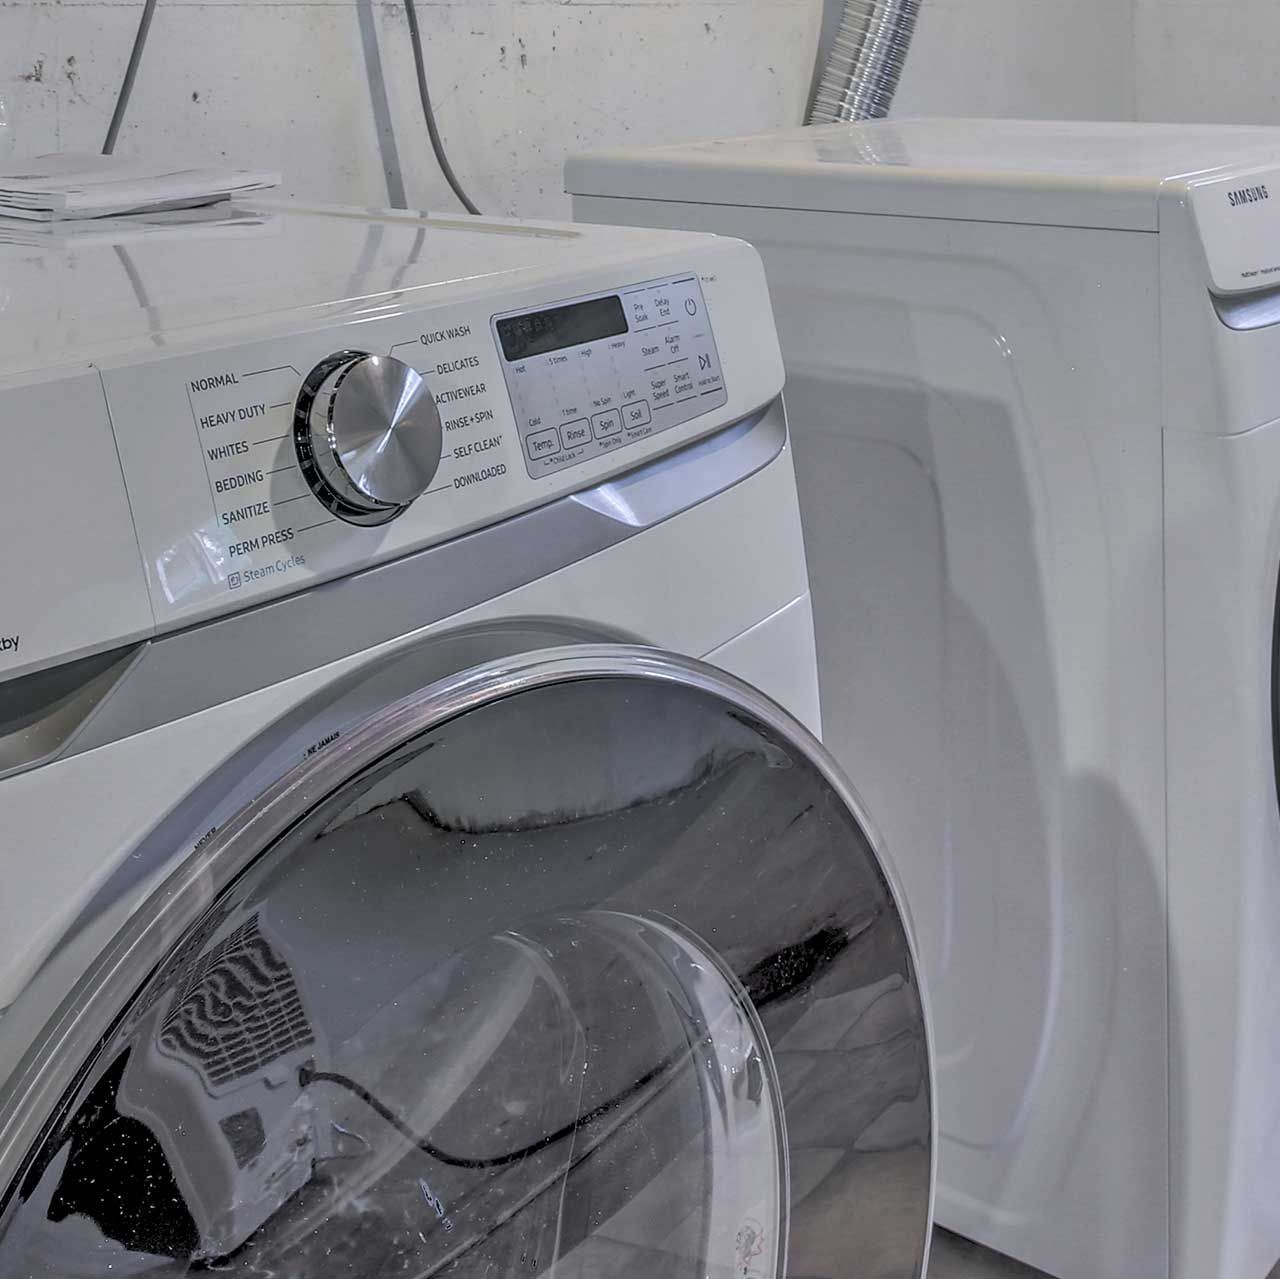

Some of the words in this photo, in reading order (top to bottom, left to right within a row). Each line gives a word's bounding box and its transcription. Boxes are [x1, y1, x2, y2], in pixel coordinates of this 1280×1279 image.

[1228, 185, 1268, 206] SAMSUNG
[420, 330, 445, 345] QUICK
[446, 326, 471, 340] WASH
[641, 346, 660, 356] Steam
[437, 356, 480, 375] DELICATES
[191, 373, 239, 392] NORMAL
[435, 383, 486, 405] ACTIVEWEAR
[200, 410, 236, 429] HEAVY
[238, 404, 266, 421] DUTY
[630, 408, 642, 421] Soil
[566, 429, 586, 441] Rinse
[600, 420, 615, 432] Spin
[207, 441, 249, 461] WHITES
[453, 442, 473, 459] SELF
[532, 439, 555, 452] Temp.
[215, 470, 264, 493] BEDDING
[453, 464, 506, 489] DOWNLOADED
[222, 502, 270, 525] SANITIZE
[229, 538, 260, 558] PERM
[262, 528, 294, 548] PRESS
[243, 564, 274, 583] Steam
[275, 554, 306, 574] Cycles
